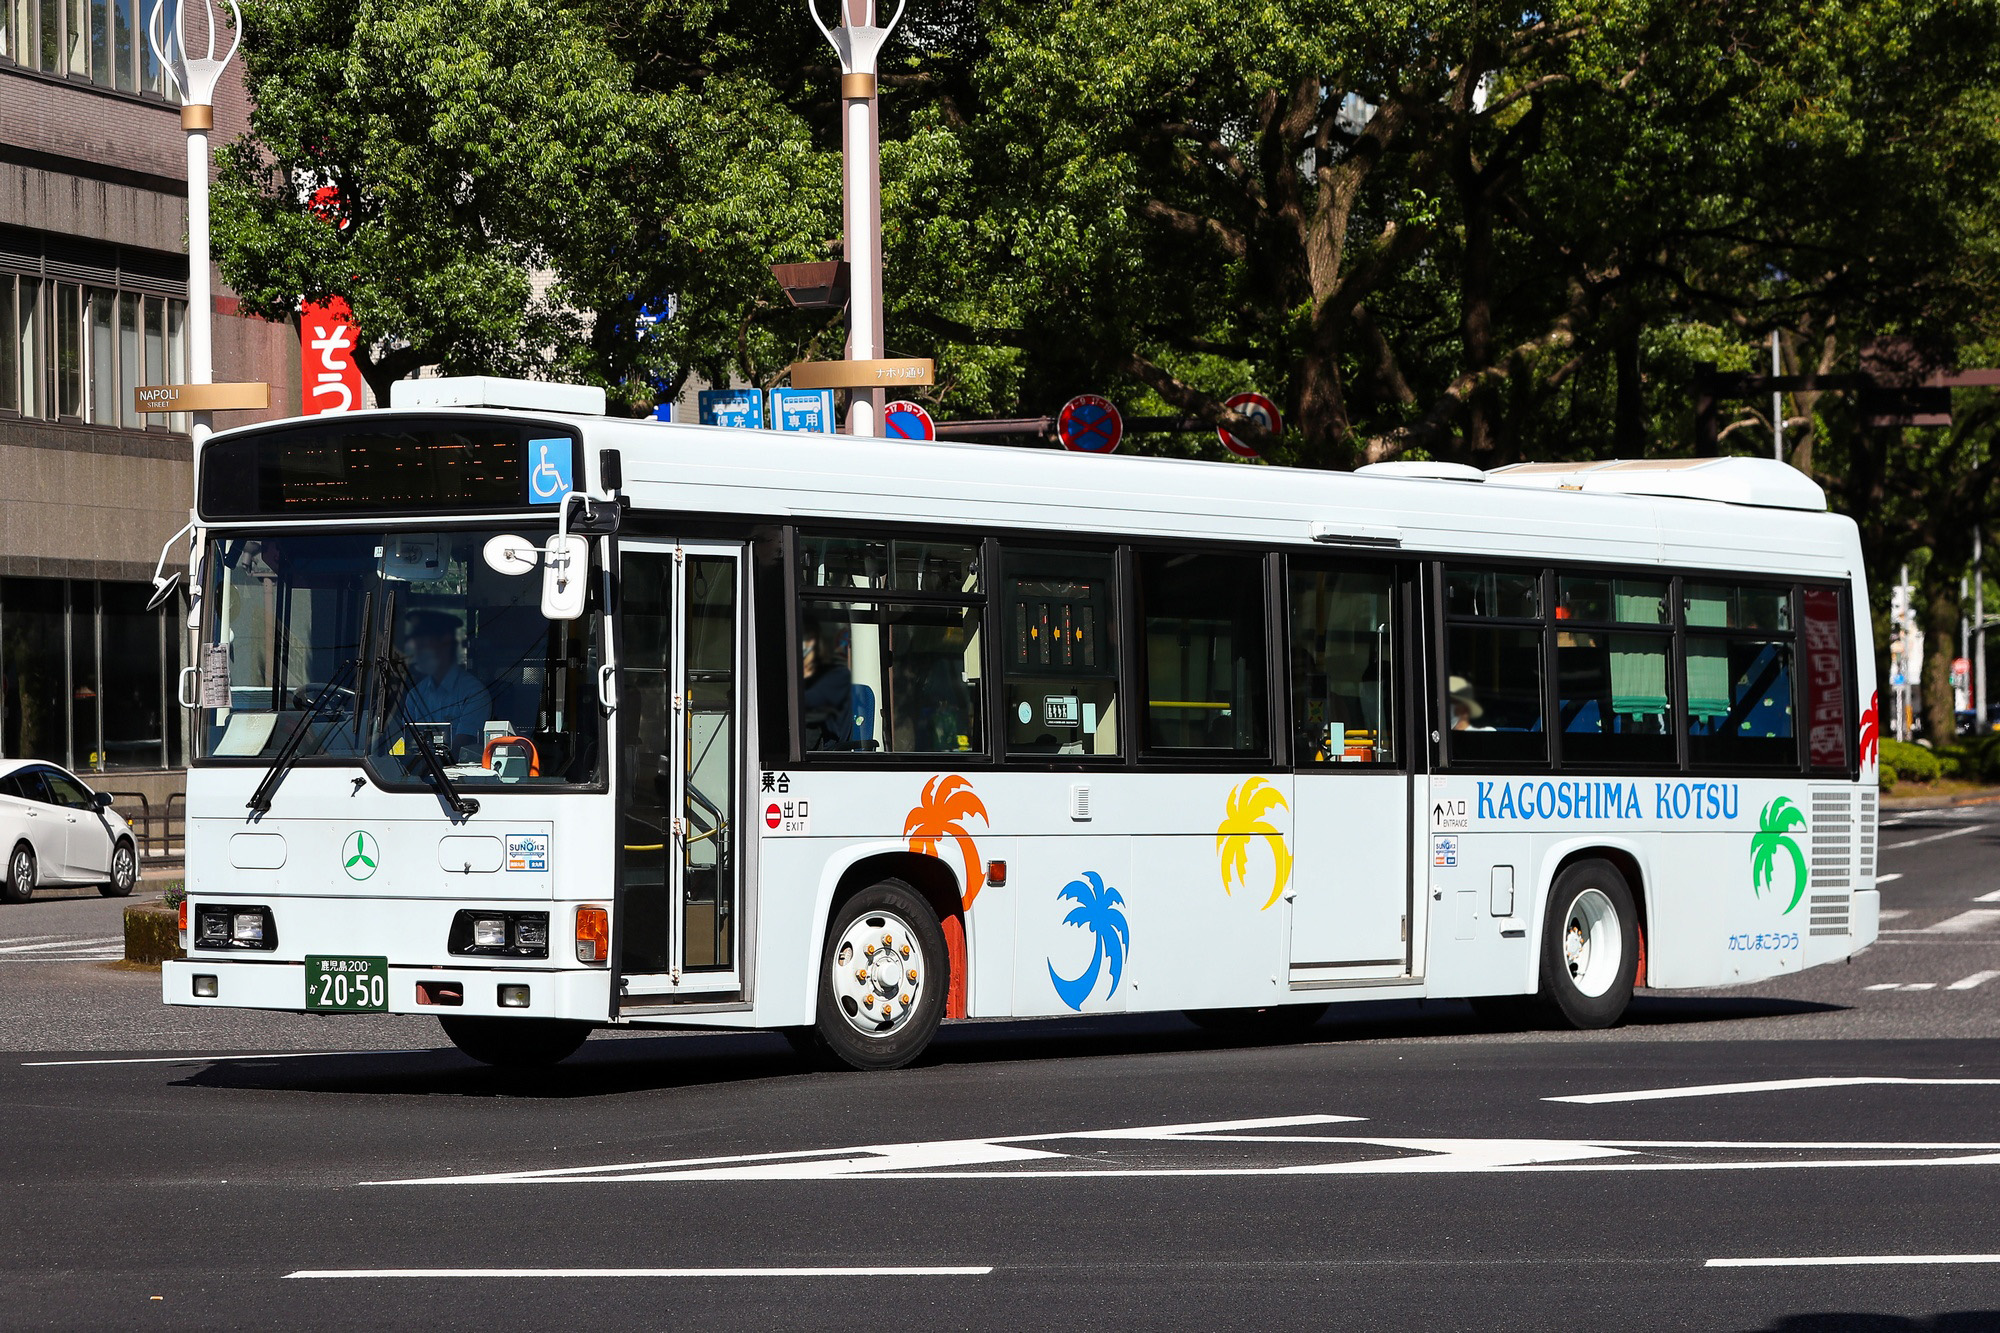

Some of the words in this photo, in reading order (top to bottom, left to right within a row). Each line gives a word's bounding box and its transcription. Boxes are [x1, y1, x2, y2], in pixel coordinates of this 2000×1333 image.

[139, 388, 179, 401] NAPOLI
[903, 403, 924, 418] 19-7
[717, 415, 746, 428] 優先
[788, 413, 819, 428] 専用
[761, 771, 791, 793] 乗合
[1446, 800, 1466, 816] 入口
[1476, 781, 1643, 820] KAGOSHIMA
[1655, 782, 1739, 820] KOTSU
[783, 800, 808, 818] 出口
[786, 821, 805, 832] EXIT
[1443, 819, 1468, 828] ENTRANCE
[1728, 932, 1800, 951] かごしまこうつう
[320, 960, 368, 972] 鹿児島200
[309, 984, 318, 995] か
[319, 974, 384, 1007] 20-50
